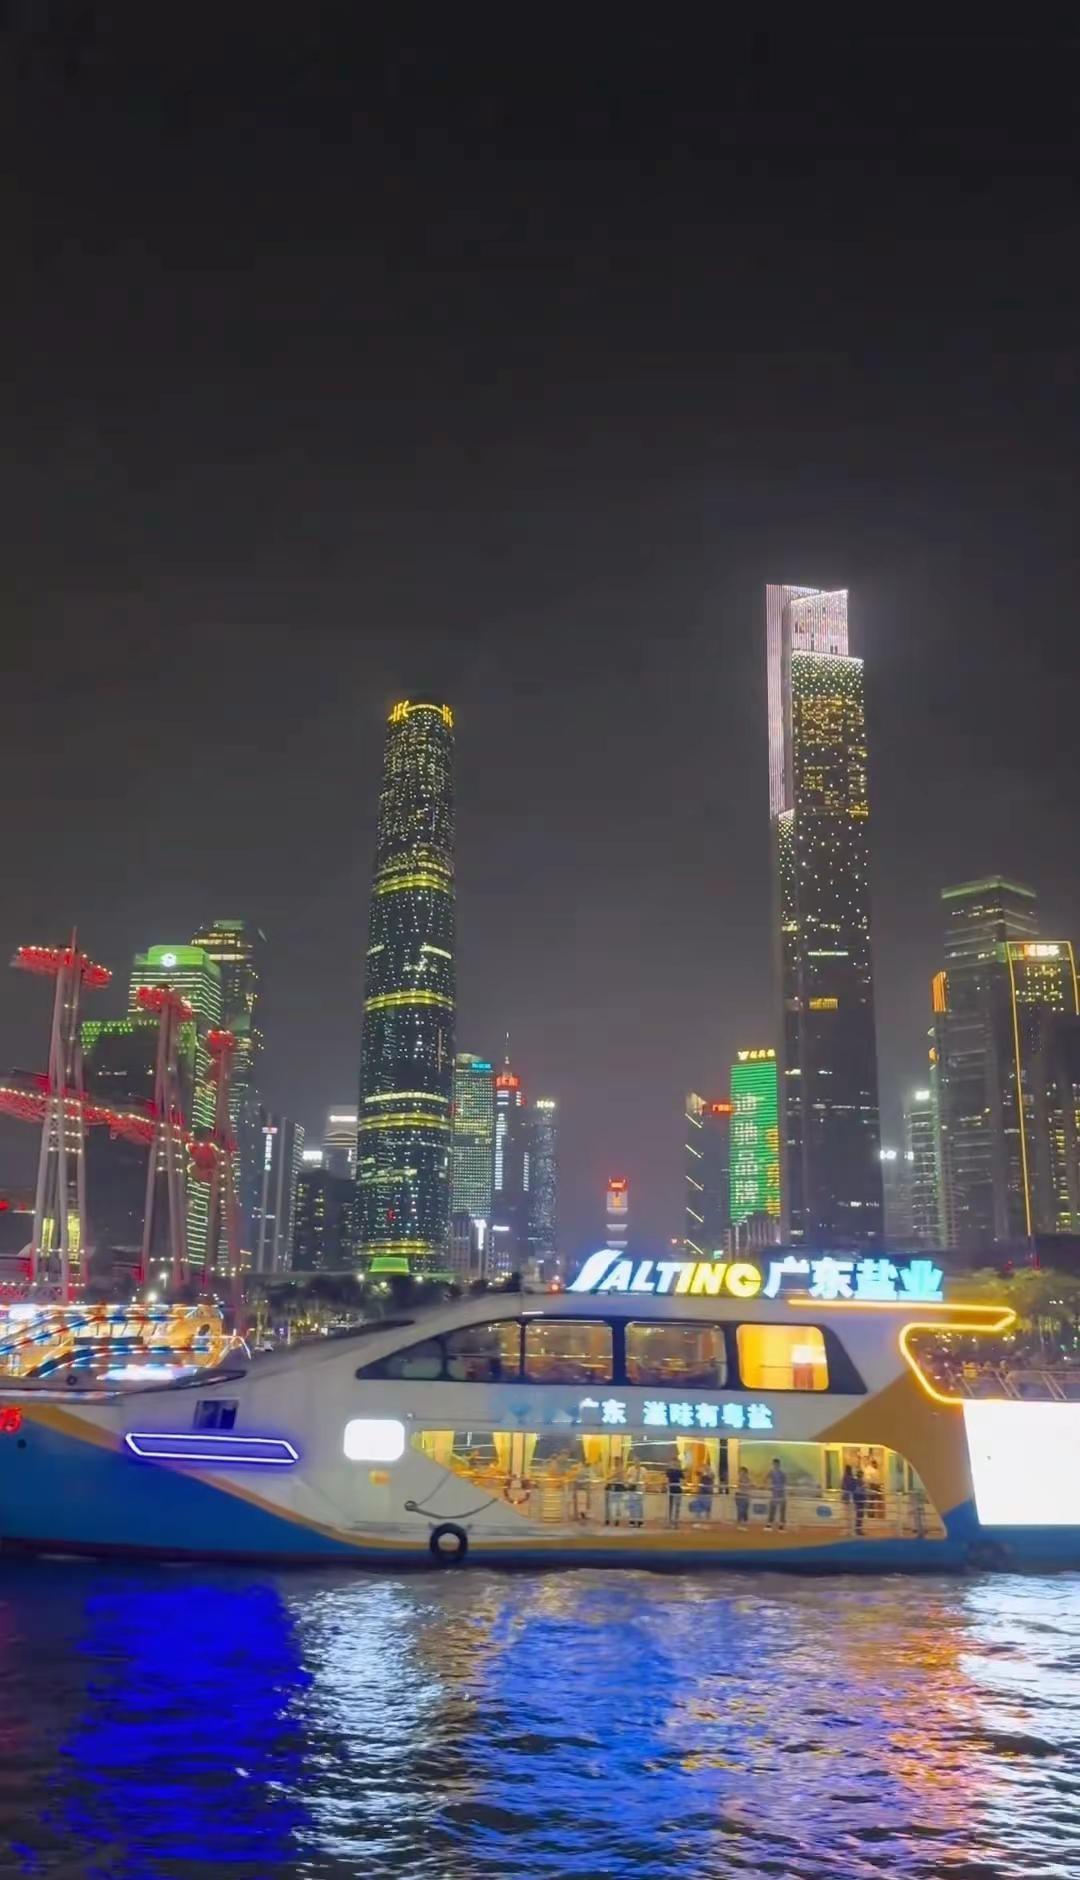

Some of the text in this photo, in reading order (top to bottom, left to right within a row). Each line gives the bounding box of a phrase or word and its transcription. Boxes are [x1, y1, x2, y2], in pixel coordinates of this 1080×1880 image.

[566, 1248, 762, 1298] SALTING
[763, 1256, 944, 1301] 广东盐业
